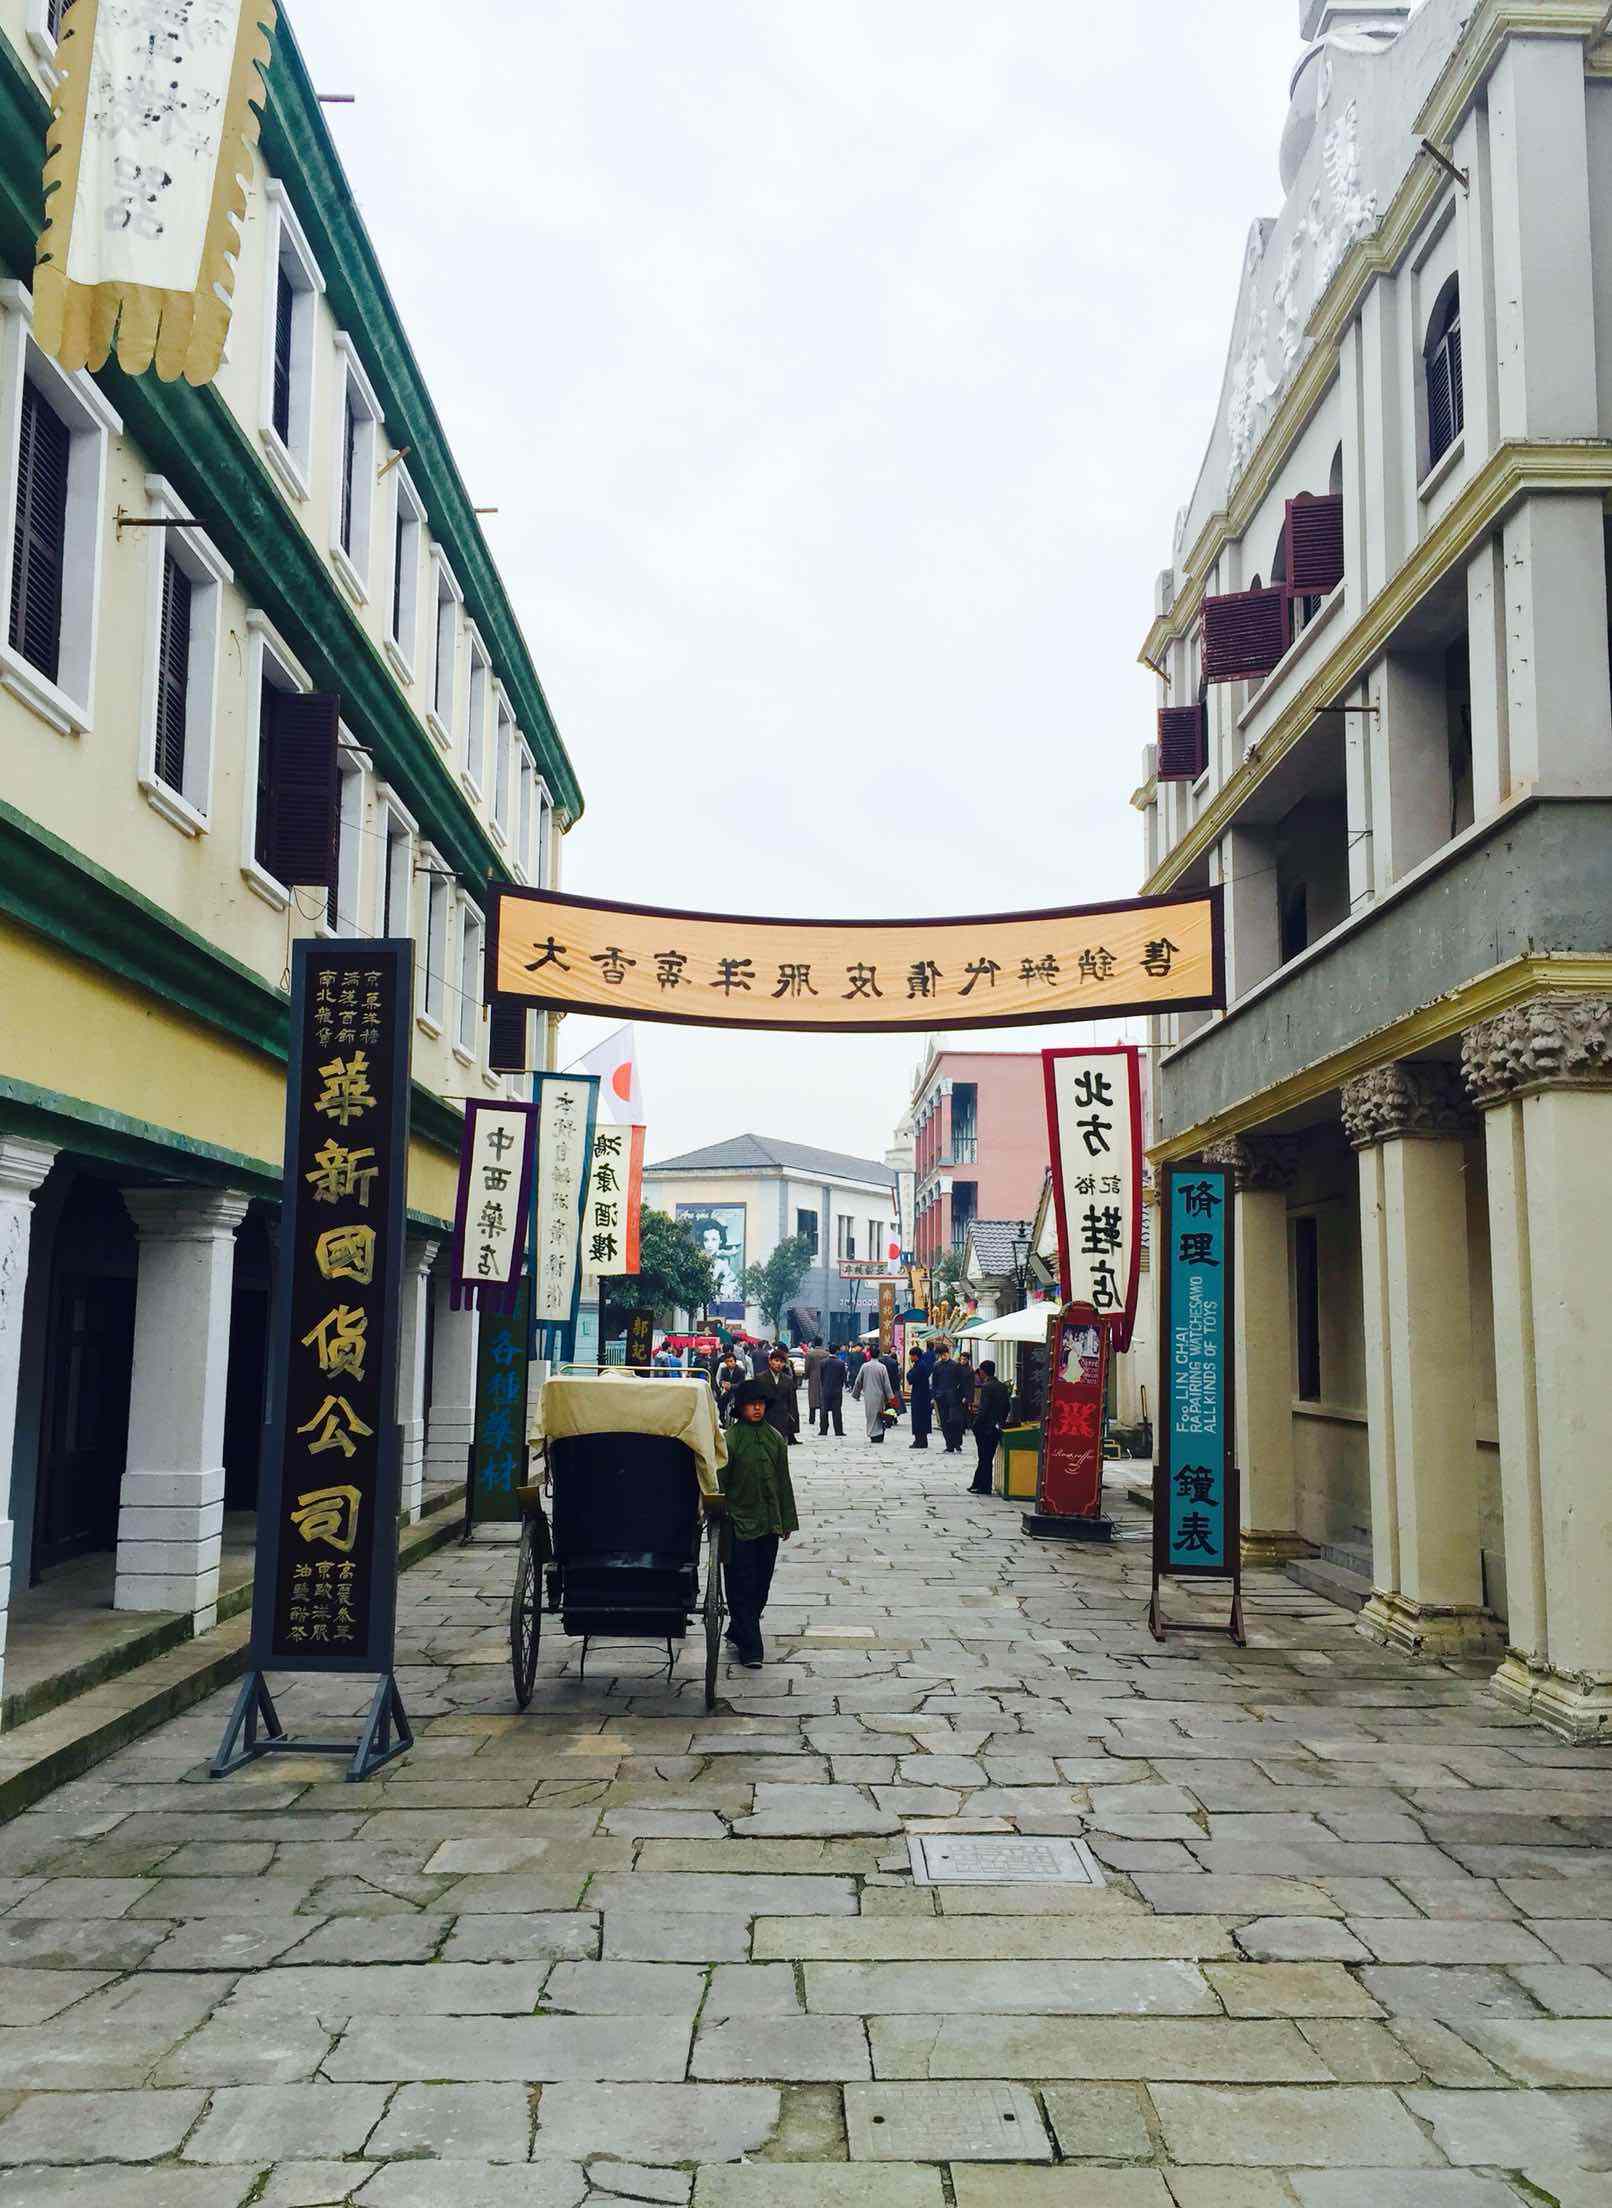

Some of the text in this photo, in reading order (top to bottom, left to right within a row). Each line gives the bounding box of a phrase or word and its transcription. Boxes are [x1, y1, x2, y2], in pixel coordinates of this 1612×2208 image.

[291, 1050, 378, 1552] 華新國貨公司
[1204, 1301, 1217, 1334] TOYS
[1176, 1327, 1188, 1364] CHAI
[1204, 1340, 1216, 1357] OF
[1176, 1372, 1188, 1400] LIN
[1204, 1362, 1216, 1404] KINDS
